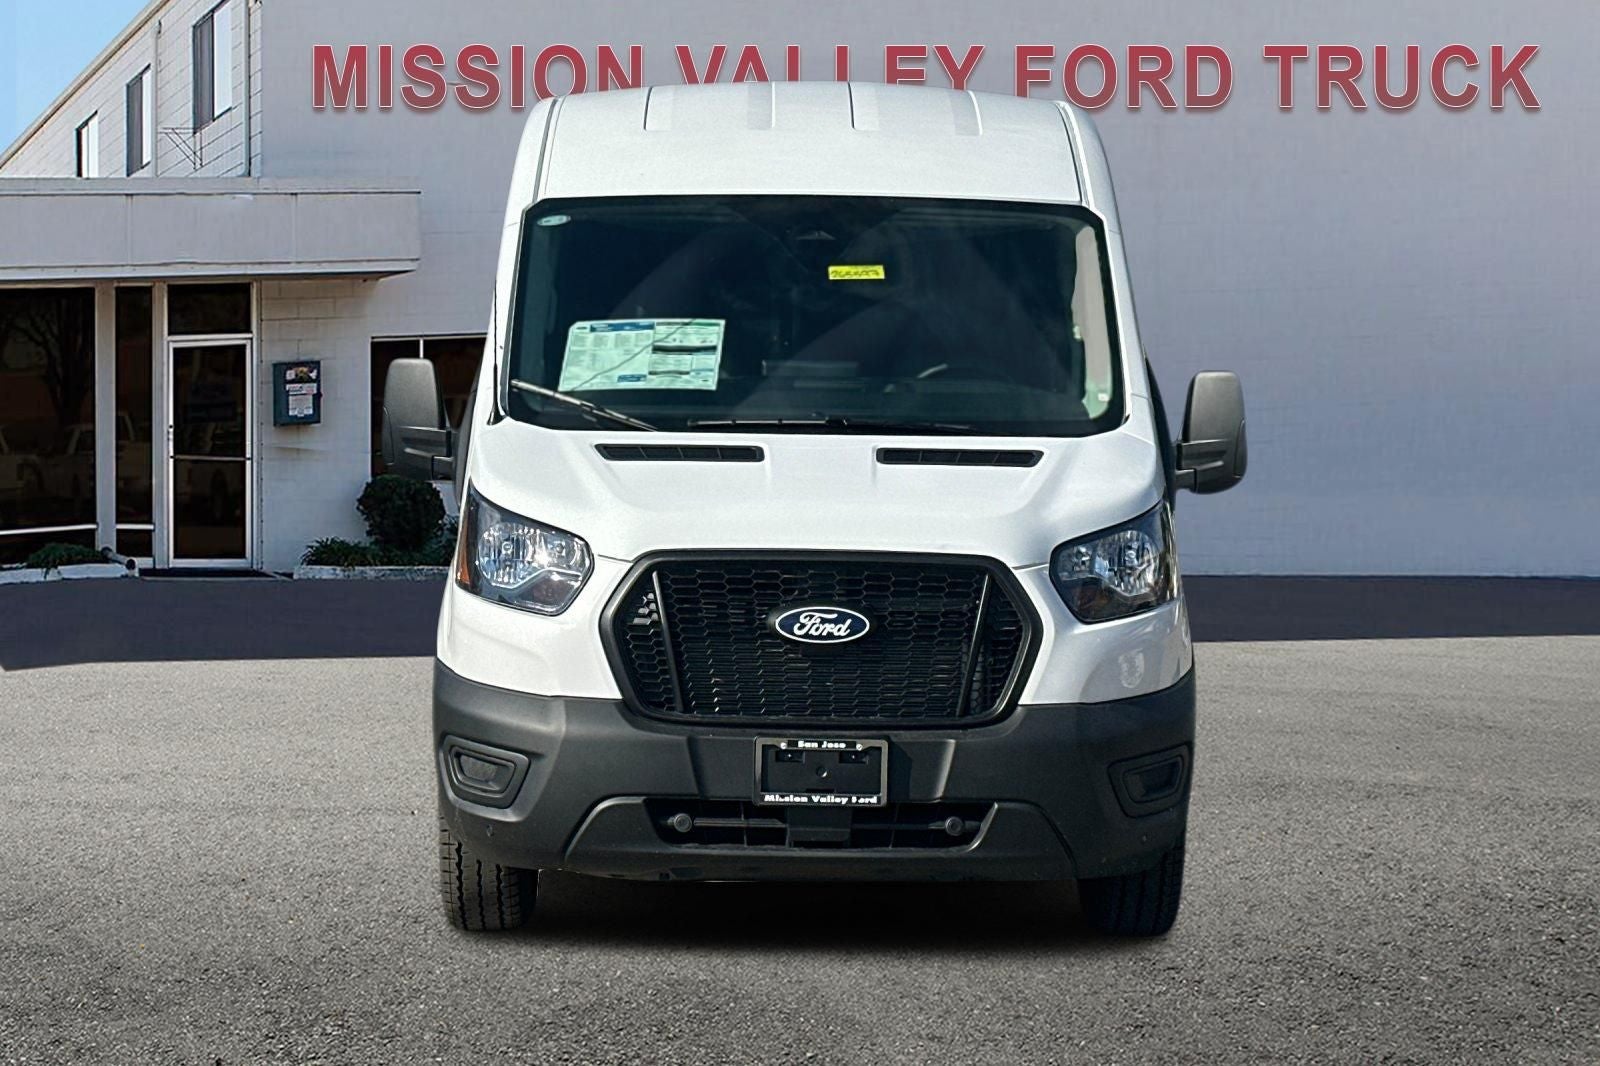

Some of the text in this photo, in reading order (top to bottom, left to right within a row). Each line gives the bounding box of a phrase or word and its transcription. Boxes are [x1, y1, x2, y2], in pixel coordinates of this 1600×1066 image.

[312, 43, 643, 109] MISSION
[1014, 43, 1233, 108] FORD
[1263, 43, 1539, 109] TRUCK
[793, 611, 853, 637] Ford
[797, 740, 819, 749] San
[811, 795, 849, 805] Valley
